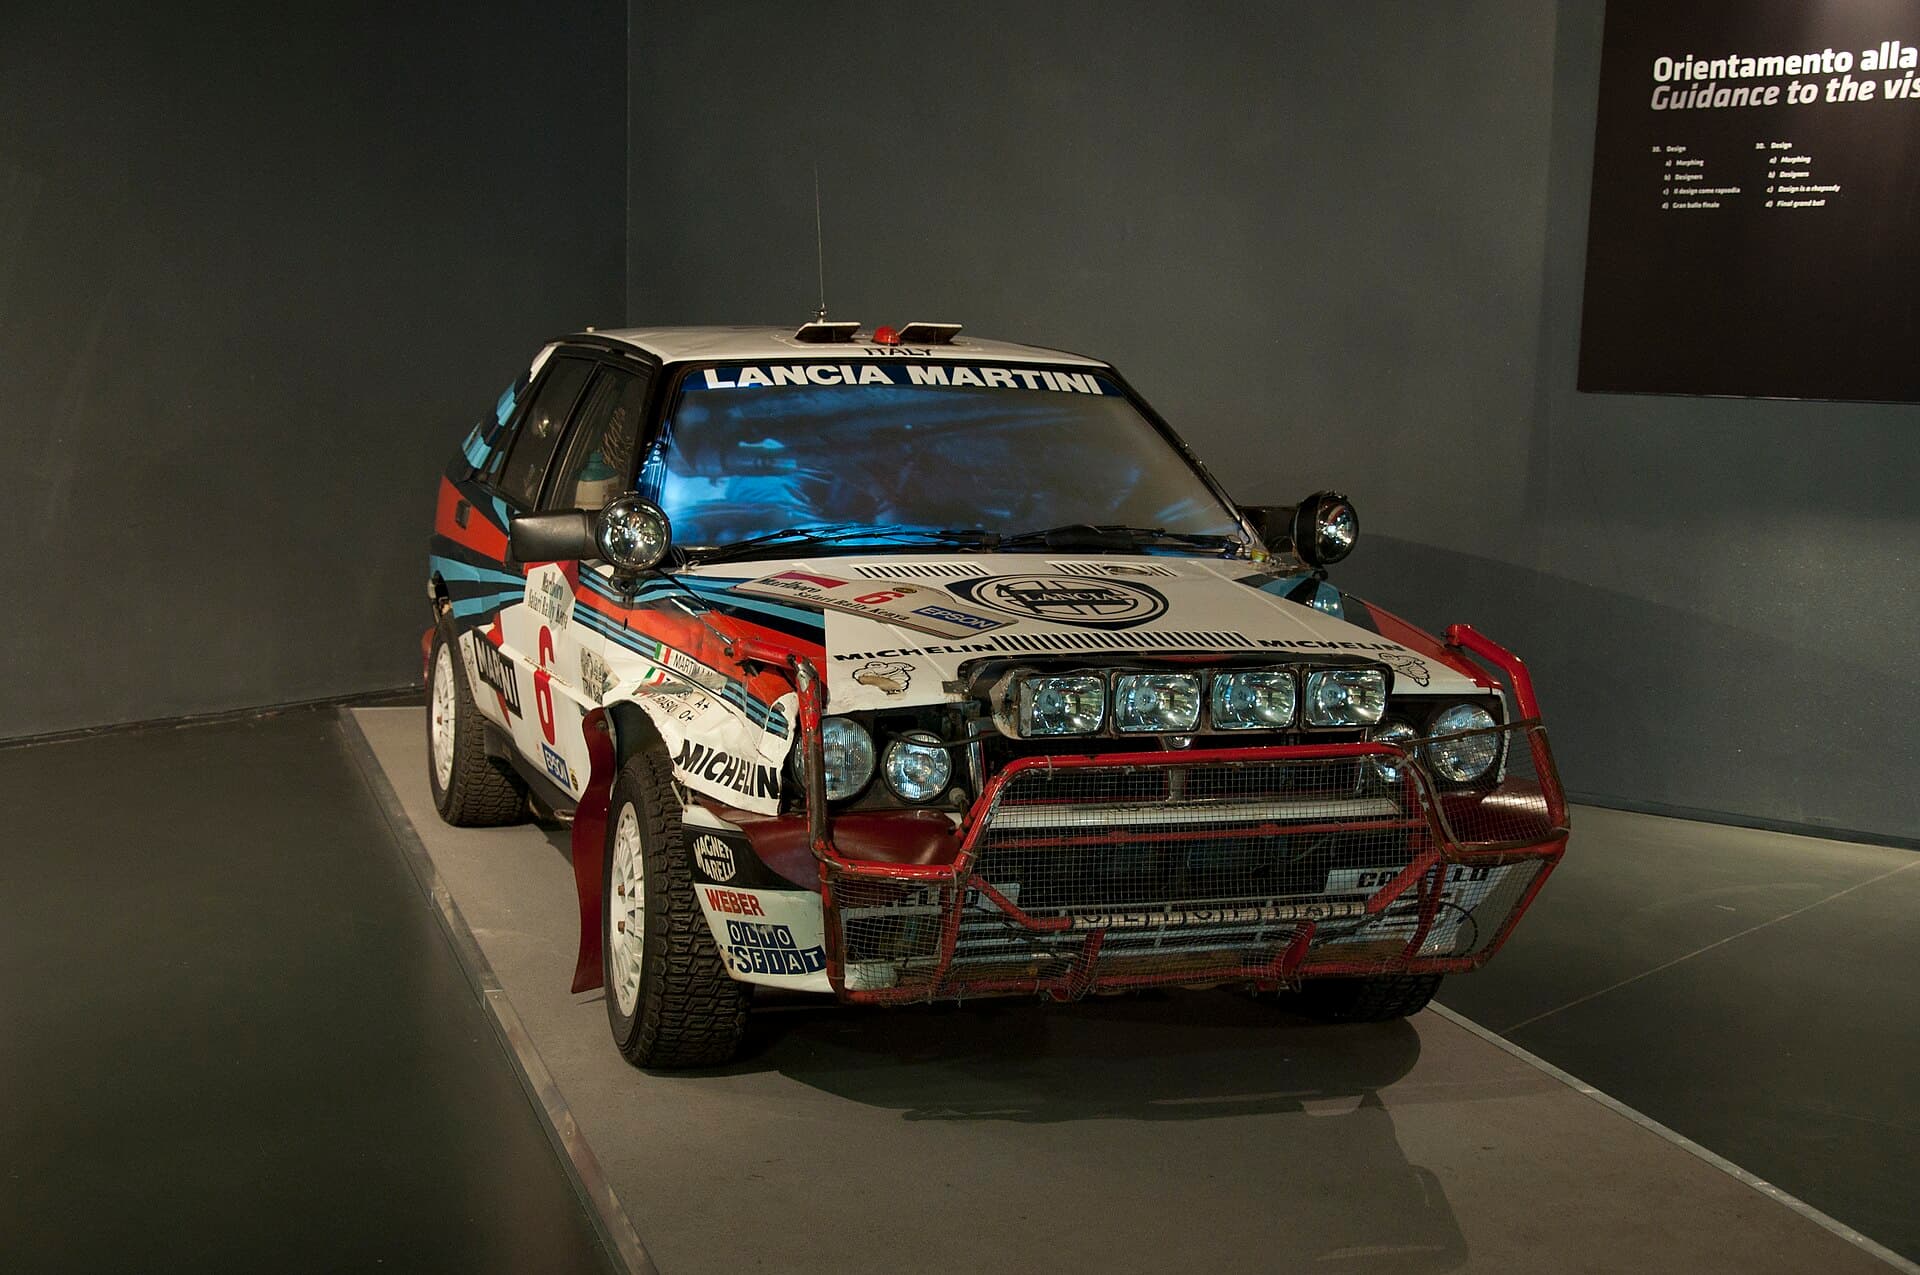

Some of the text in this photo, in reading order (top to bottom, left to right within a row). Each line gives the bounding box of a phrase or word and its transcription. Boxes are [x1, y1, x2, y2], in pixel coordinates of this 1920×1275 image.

[1653, 40, 1918, 82] Orientamento alla
[1650, 70, 1920, 110] Guidance to the vis
[1666, 145, 1687, 154] Design
[1770, 141, 1793, 151] Design
[1675, 159, 1705, 168] Morphing
[1780, 155, 1812, 165] Morphing
[1679, 187, 1698, 196] design
[1777, 185, 1799, 194] Design
[1776, 199, 1793, 208] Final
[703, 364, 1104, 396] LANCIA MARTINI
[853, 591, 905, 604] 6
[921, 606, 994, 629] EPSON
[833, 643, 997, 661] MICHELIN
[1255, 639, 1408, 652] MICHELIN
[534, 625, 556, 746] 6
[673, 738, 779, 800] MICHELIN
[704, 888, 765, 917] WEBER
[730, 924, 792, 946] OLIO
